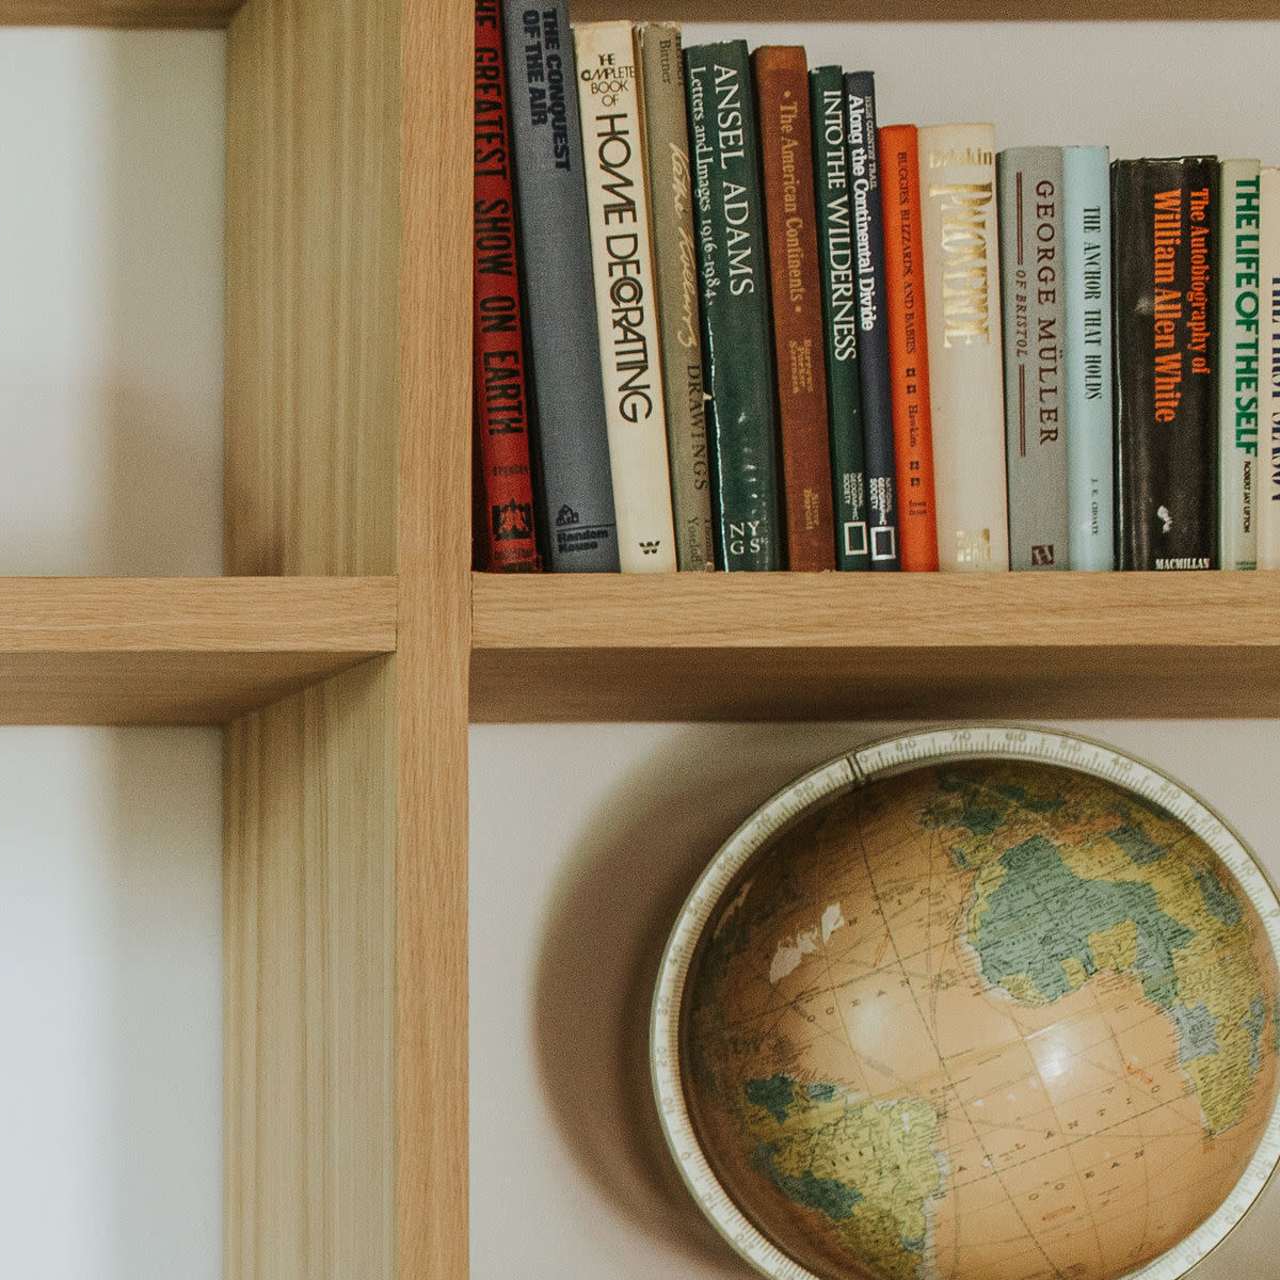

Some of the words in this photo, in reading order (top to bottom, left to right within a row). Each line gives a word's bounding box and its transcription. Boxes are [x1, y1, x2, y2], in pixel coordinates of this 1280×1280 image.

[522, 9, 540, 38] OF
[542, 8, 560, 50] THE
[525, 42, 544, 84] THE
[590, 80, 629, 95] BOOK
[475, 47, 507, 179] GREATEST
[528, 86, 549, 127] AIR
[546, 54, 571, 172] CONQUEST
[601, 94, 619, 107] OF
[690, 66, 707, 121] Letters
[713, 64, 746, 170] ANSEL
[778, 103, 799, 132] The
[823, 90, 843, 145] INTO
[848, 94, 864, 147] Along
[695, 124, 713, 154] and
[852, 148, 864, 176] the
[595, 113, 637, 226] HOME
[696, 152, 714, 215] Images
[780, 134, 801, 217] American
[828, 147, 846, 189] THE
[853, 178, 875, 274] Continental
[1083, 206, 1101, 234] THE
[1189, 188, 1210, 222] The
[1235, 175, 1261, 230] THE
[476, 200, 512, 276] SHOW
[723, 183, 755, 297] ADAMS
[786, 220, 804, 303] Continents
[1036, 180, 1057, 305] GEORGE
[1153, 188, 1182, 284] William
[1235, 234, 1260, 289] LIFE
[828, 194, 856, 360] WILDERNESS
[1015, 269, 1027, 290] OF
[1083, 242, 1102, 301] ANCHOR
[1186, 225, 1211, 353] Autobiography
[482, 295, 516, 334] ON
[860, 275, 875, 331] Divide
[1016, 294, 1029, 358] BRISTOL
[1083, 308, 1102, 347] THAT
[1153, 286, 1183, 350] Allen
[1235, 291, 1260, 336] OF
[1038, 318, 1064, 445] MÜLLER
[1084, 354, 1103, 401] HOLDS
[1154, 352, 1183, 424] White
[1190, 357, 1211, 376] of
[1235, 336, 1260, 393] THE
[488, 350, 525, 436] EARTH
[686, 365, 709, 491] DRAWINGS
[1235, 394, 1260, 458] SELF
[1154, 557, 1211, 571] MACMILLAN
